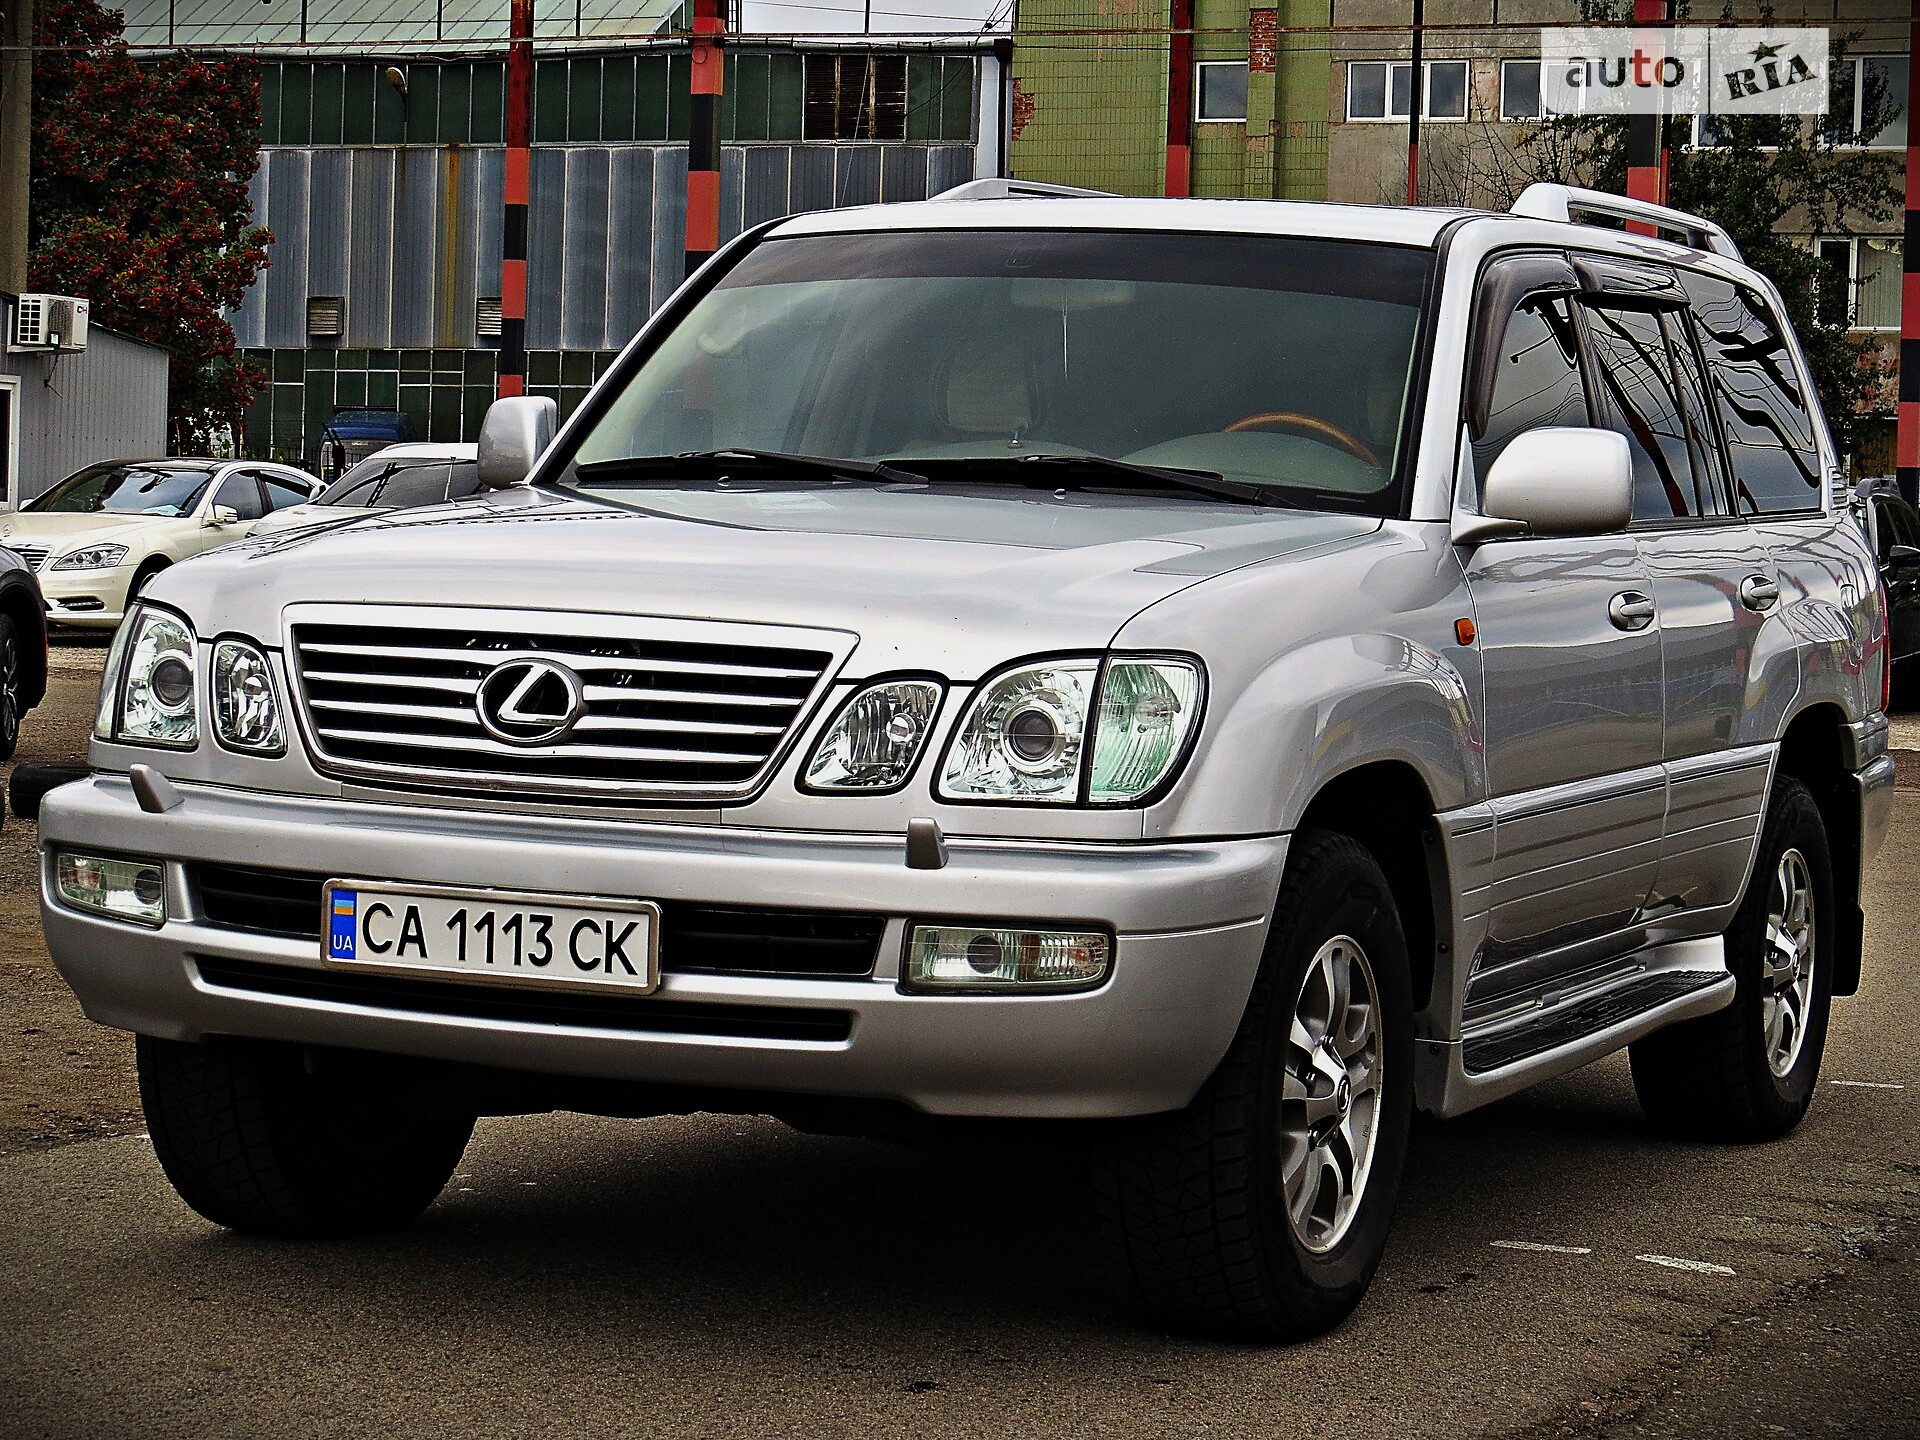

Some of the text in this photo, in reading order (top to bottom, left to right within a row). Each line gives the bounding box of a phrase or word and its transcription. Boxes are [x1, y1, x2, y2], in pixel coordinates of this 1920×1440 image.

[333, 934, 353, 951] UA
[362, 902, 640, 976] CA 1113 CK
